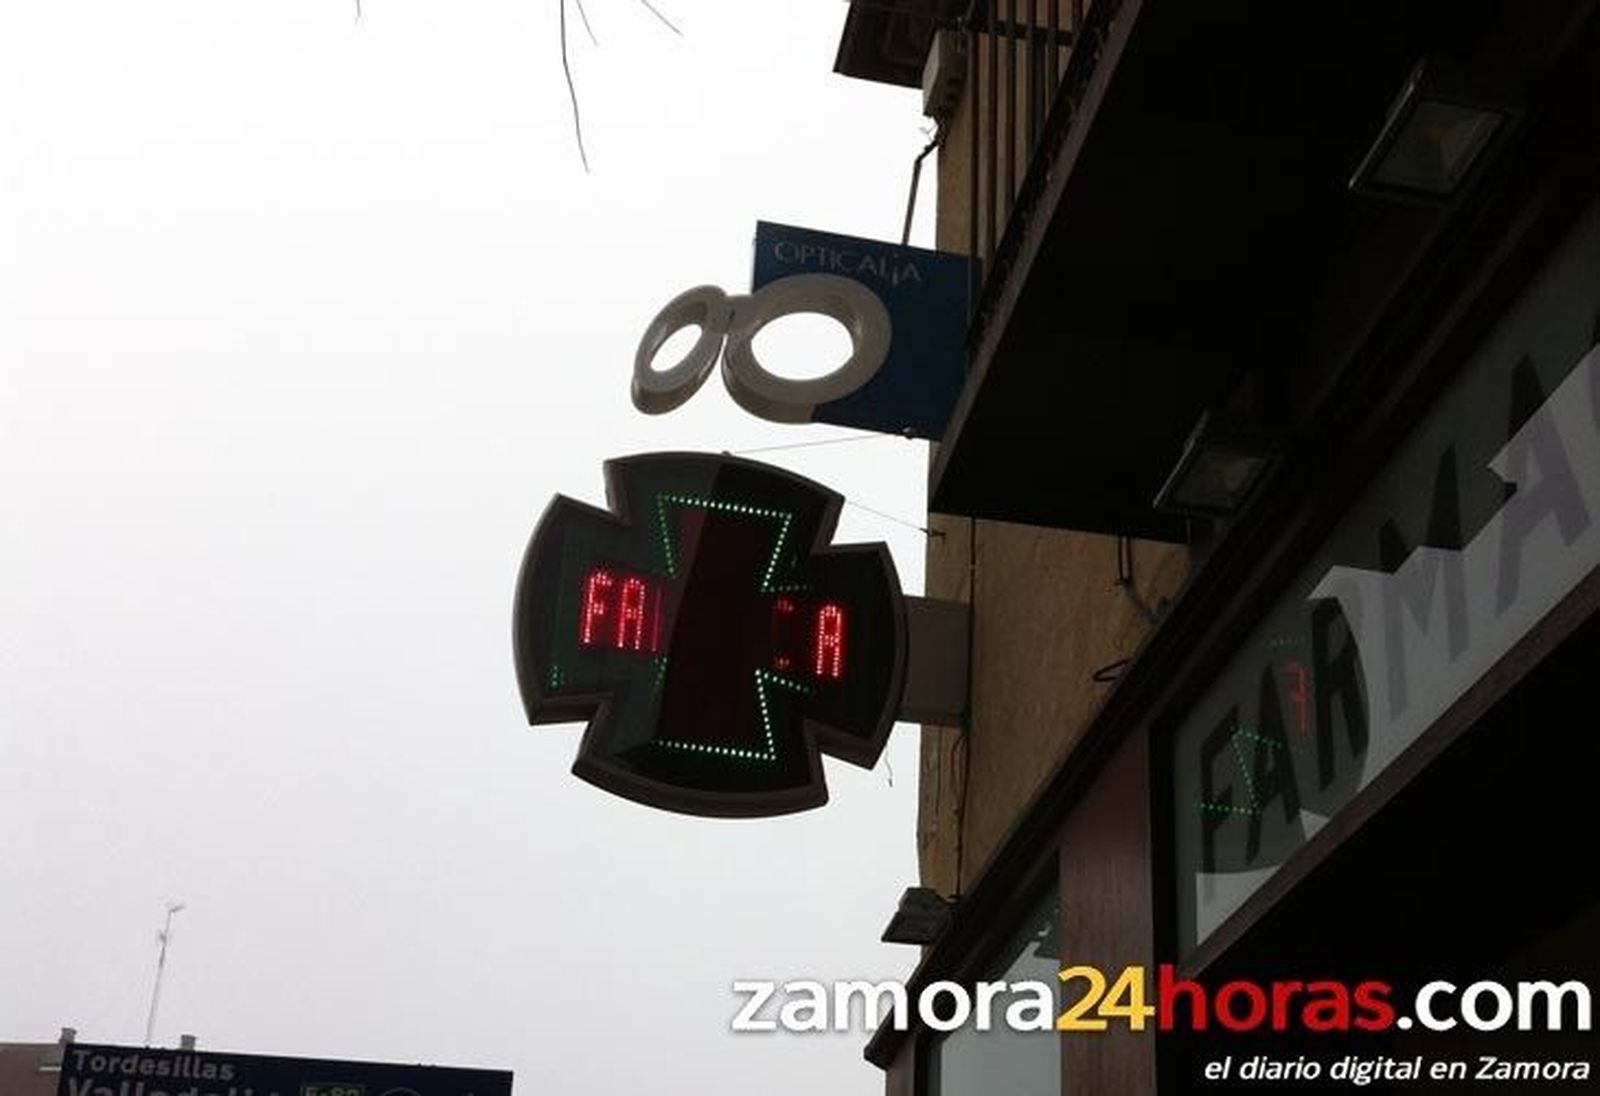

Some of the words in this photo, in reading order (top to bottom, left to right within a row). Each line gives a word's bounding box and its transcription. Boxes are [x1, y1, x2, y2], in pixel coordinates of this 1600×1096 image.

[582, 570, 662, 652] FA
[1200, 350, 1600, 904] FARMA
[73, 1049, 236, 1080] Tordesillas
